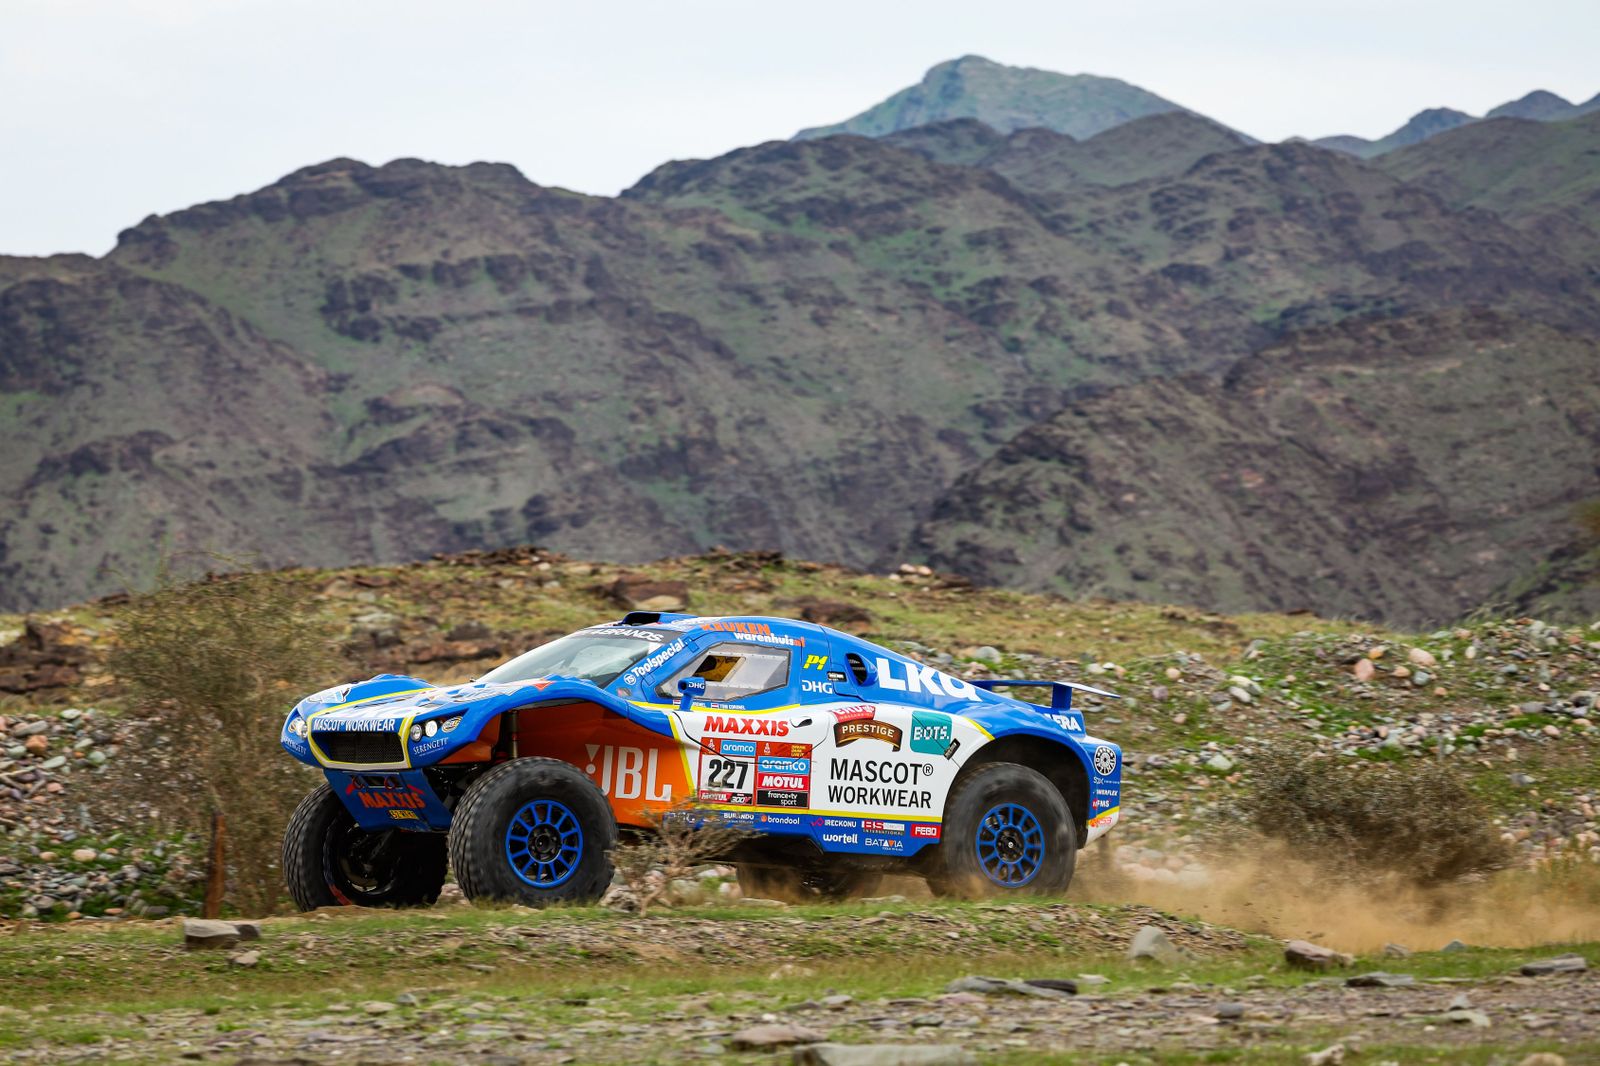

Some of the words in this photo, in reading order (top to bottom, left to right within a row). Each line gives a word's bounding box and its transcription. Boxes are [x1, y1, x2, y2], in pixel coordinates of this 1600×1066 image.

[701, 622, 771, 636] KEUKEN
[803, 654, 829, 670] P1
[688, 681, 705, 690] DHG
[876, 657, 983, 702] LKQ
[802, 680, 833, 695] DHG
[345, 718, 396, 732] WORKWEAR
[703, 716, 789, 737] MAXXIS
[842, 724, 895, 738] PRESTIGE
[722, 743, 754, 753] aramco
[761, 760, 806, 771] aramco
[601, 745, 672, 802] JBL
[707, 759, 749, 789] 227
[761, 775, 804, 789] MOTUL
[357, 792, 426, 809] MAXXIS
[828, 785, 932, 809] WORKWEAR
[768, 815, 800, 825] brondool
[915, 826, 937, 836] FEBO
[823, 834, 858, 844] wortell
